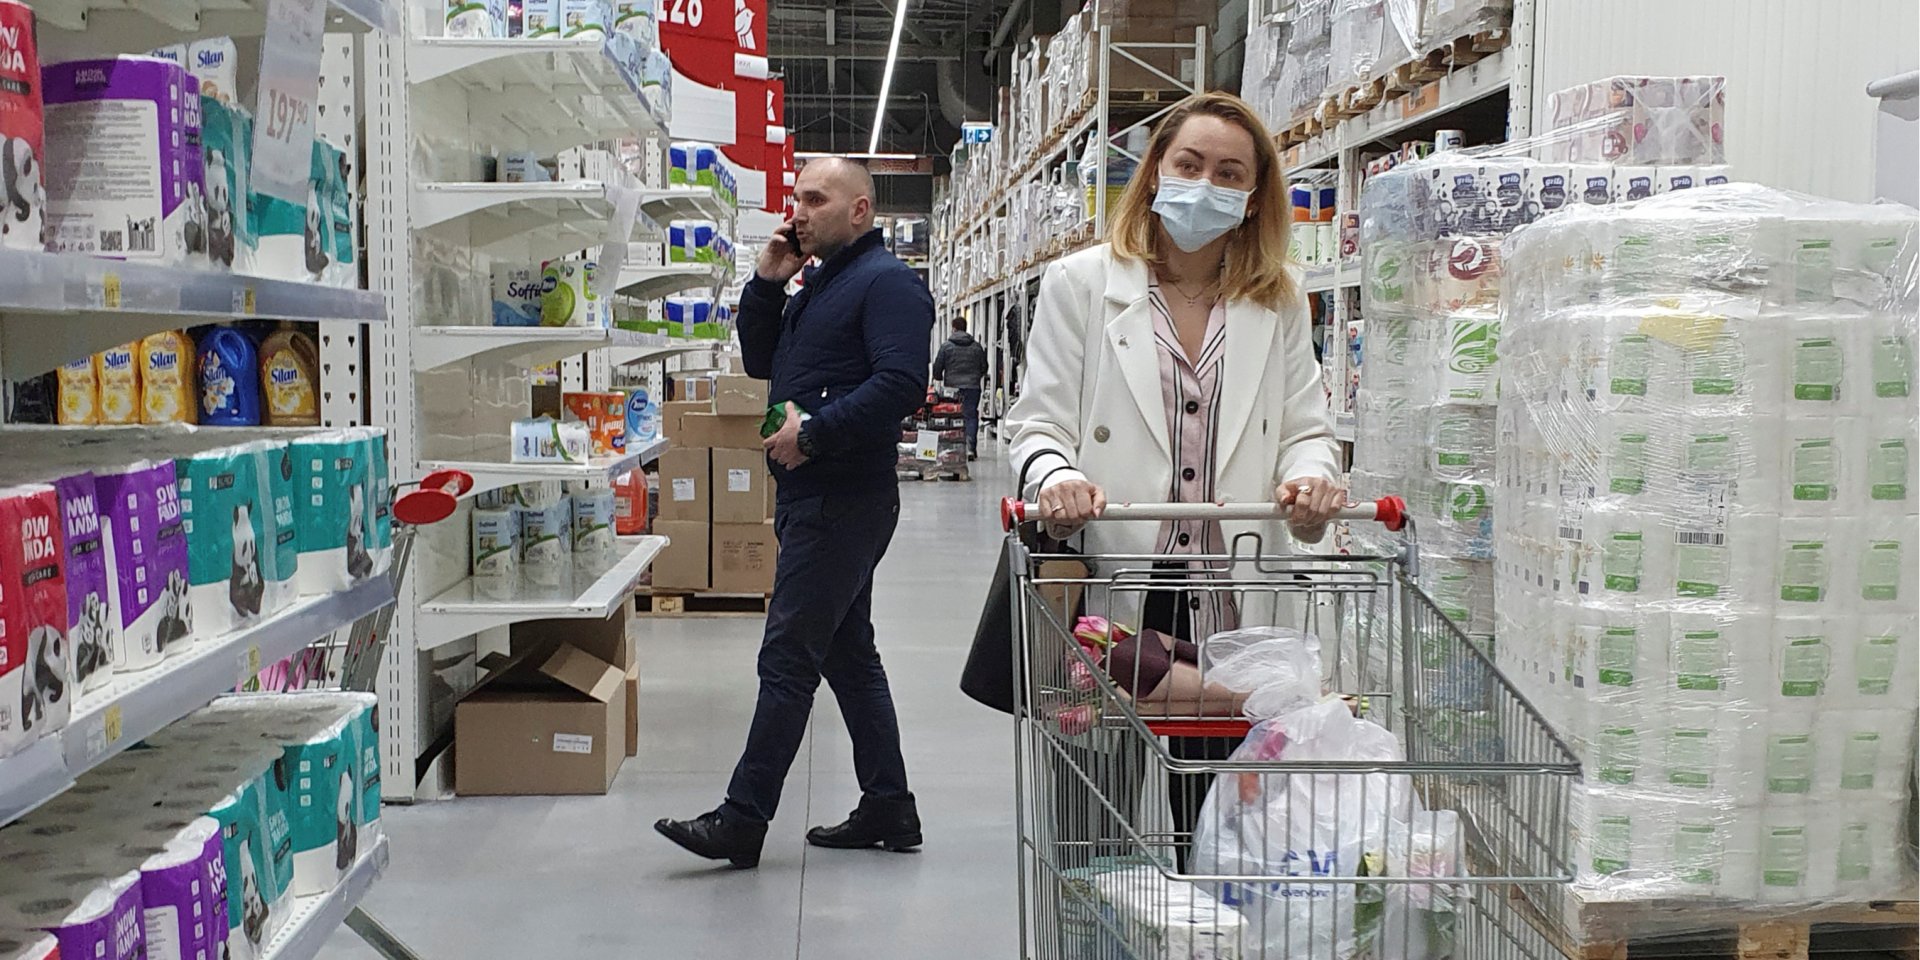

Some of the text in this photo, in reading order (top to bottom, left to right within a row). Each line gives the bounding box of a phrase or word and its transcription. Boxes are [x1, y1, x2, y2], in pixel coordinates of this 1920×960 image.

[197, 50, 224, 68] Silan
[266, 88, 297, 144] 197
[104, 351, 131, 369] Silan
[149, 351, 177, 369] Silan
[271, 368, 298, 385] Silan
